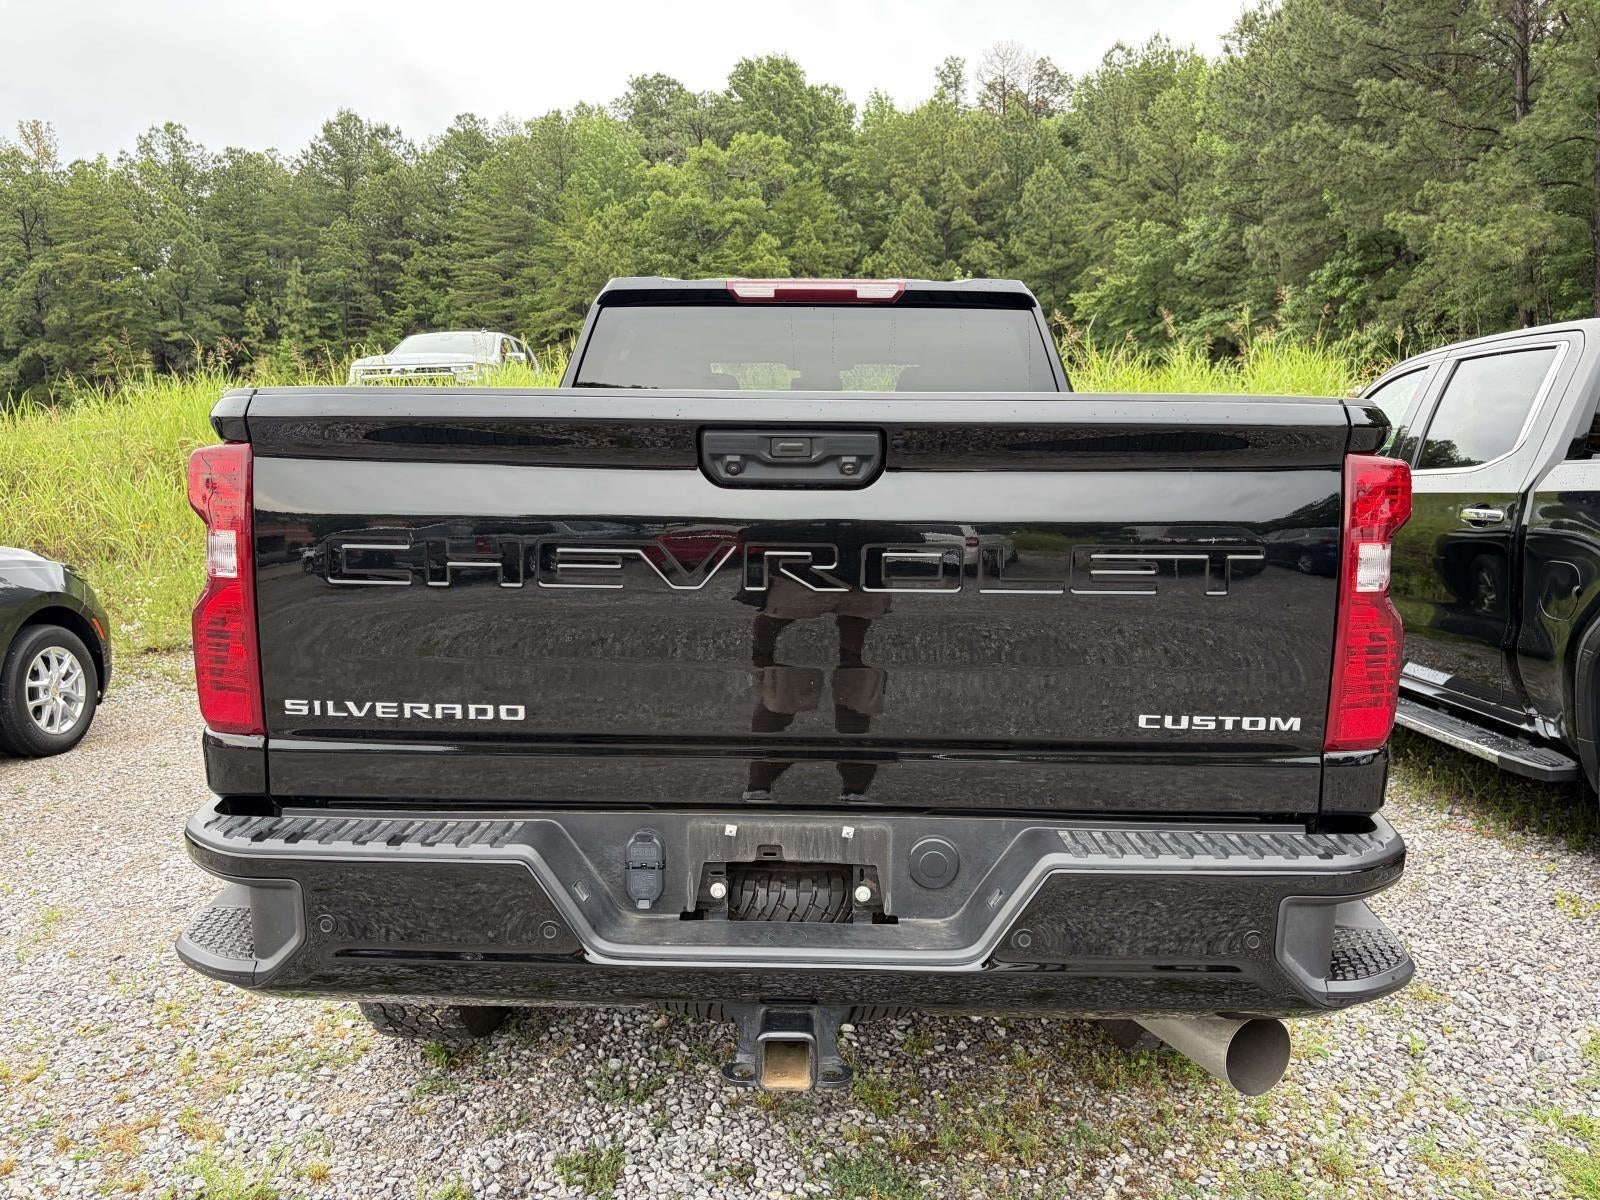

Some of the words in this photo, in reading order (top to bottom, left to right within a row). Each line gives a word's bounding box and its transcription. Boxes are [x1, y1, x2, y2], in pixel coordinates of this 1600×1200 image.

[326, 536, 1266, 596] CHEVROLET
[284, 699, 526, 721] SILVERADO
[1138, 714, 1301, 732] CUSTOM
